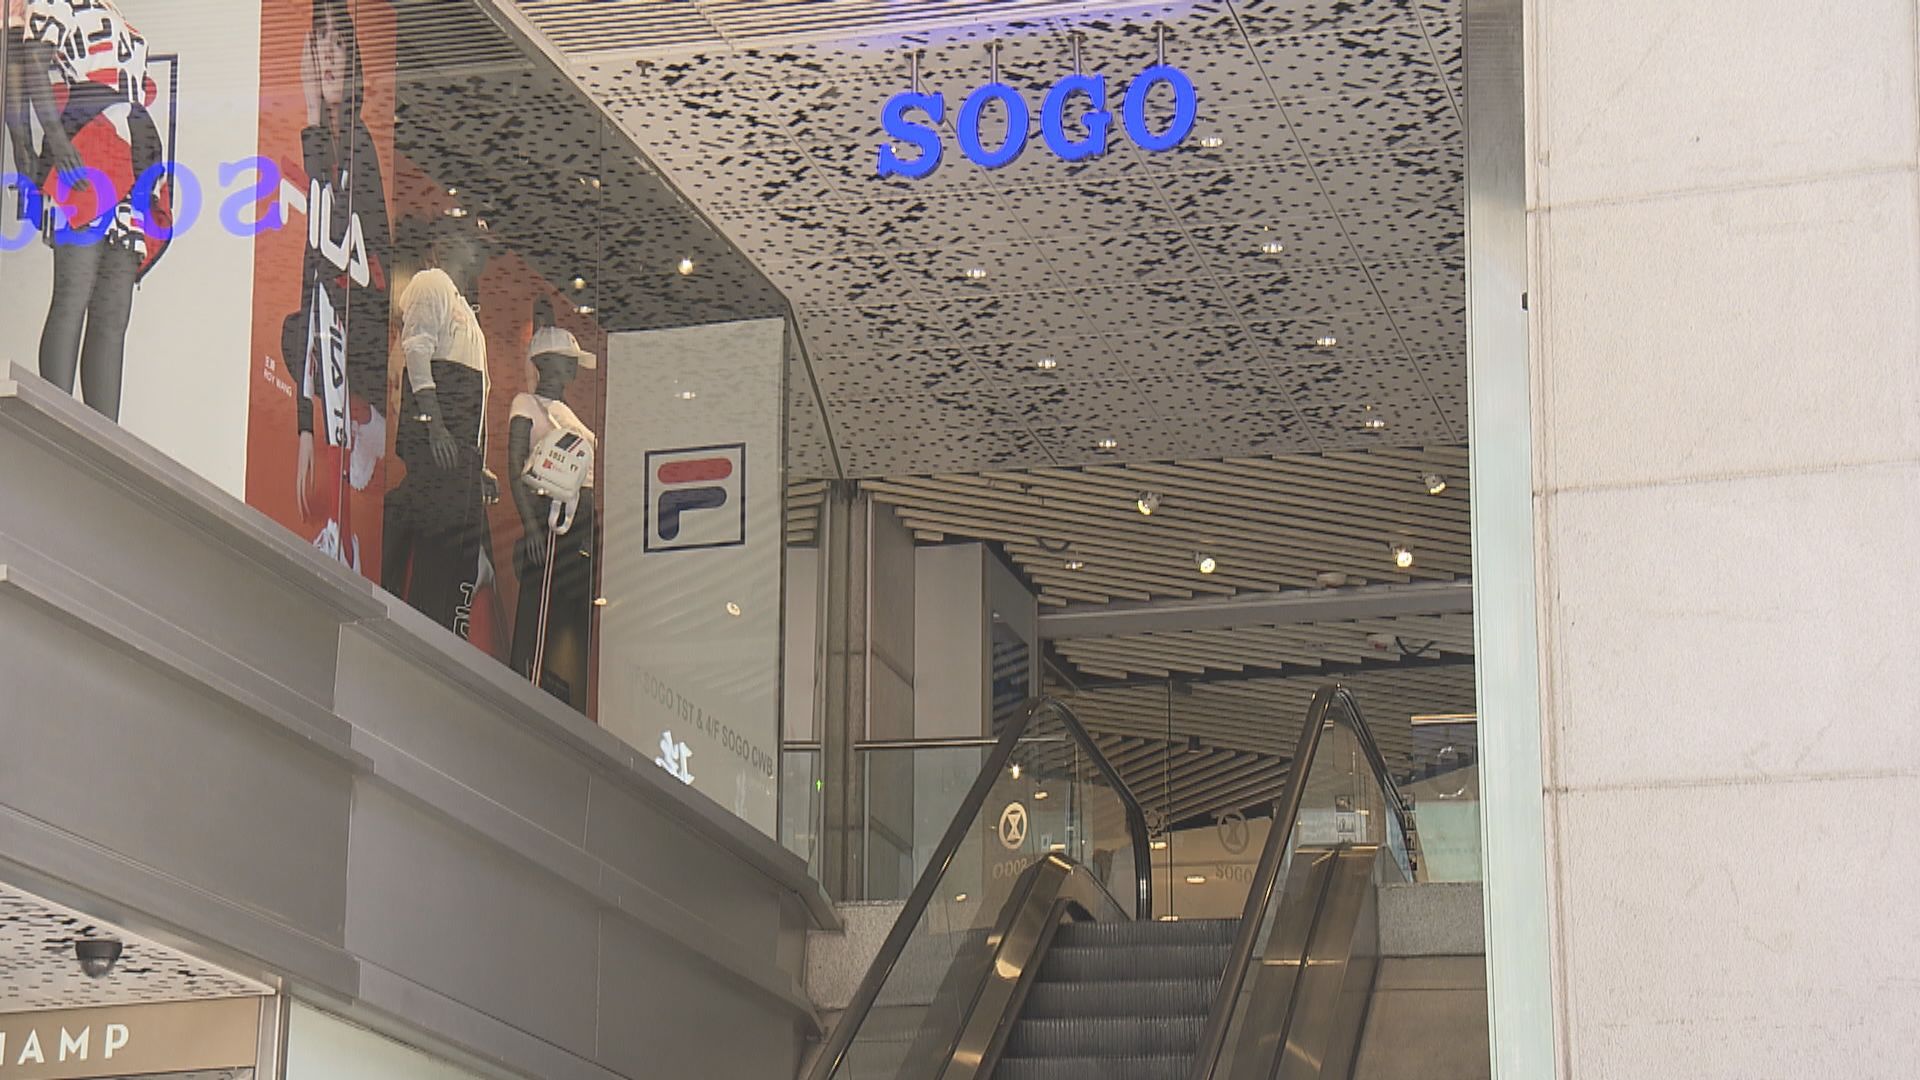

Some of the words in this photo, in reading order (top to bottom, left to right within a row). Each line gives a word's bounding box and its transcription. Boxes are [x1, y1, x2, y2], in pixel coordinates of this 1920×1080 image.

[877, 64, 1198, 180] SOGO
[279, 157, 371, 288] FILA
[263, 368, 276, 384] ROY
[643, 671, 674, 709] SOGO
[675, 693, 694, 724] TST
[696, 707, 704, 731] &
[705, 715, 721, 741] 4/F
[721, 725, 750, 761] SOGO
[751, 745, 773, 776] CWB
[1215, 863, 1253, 884] SOGO
